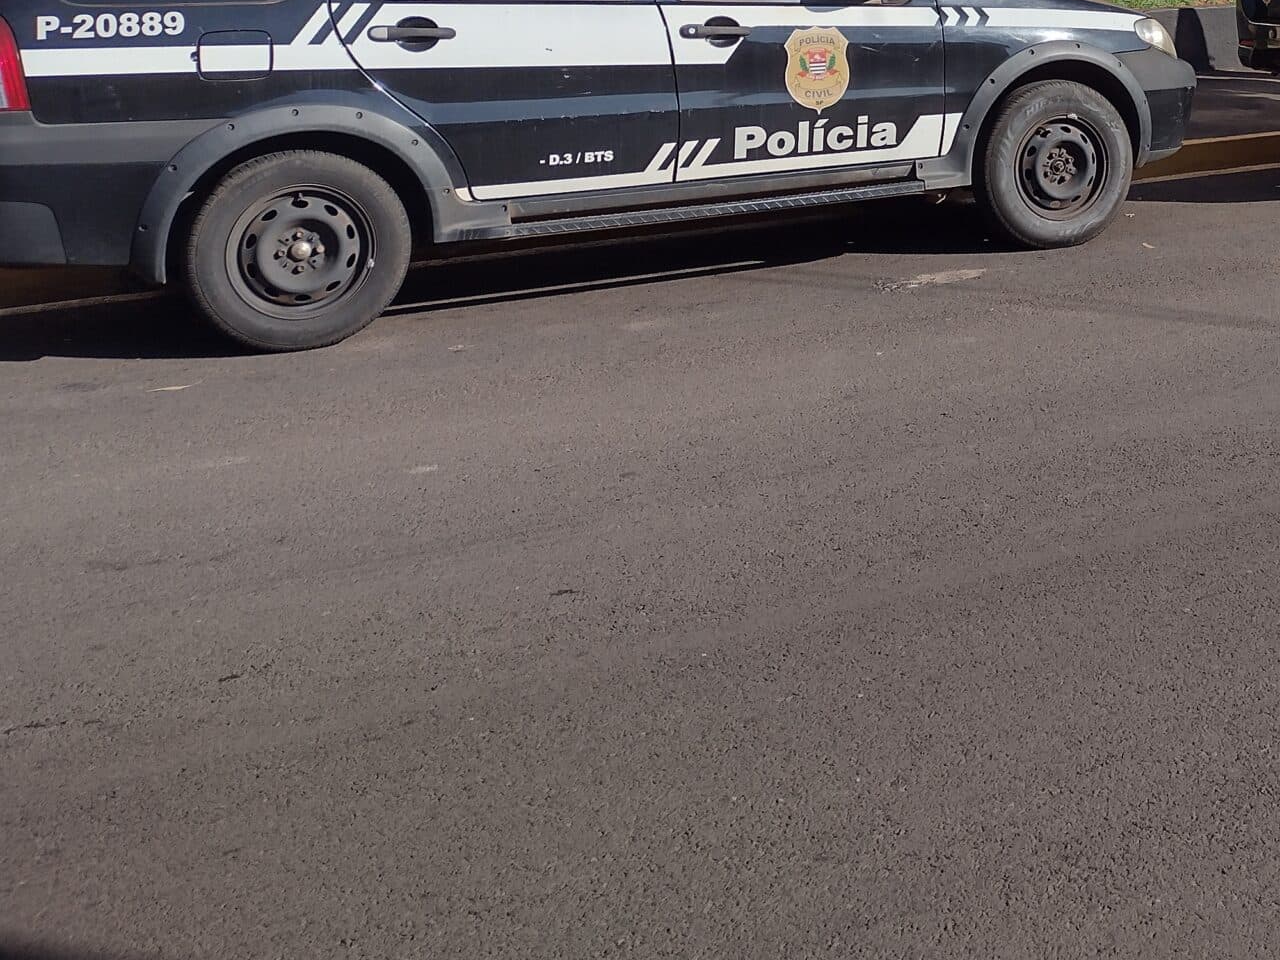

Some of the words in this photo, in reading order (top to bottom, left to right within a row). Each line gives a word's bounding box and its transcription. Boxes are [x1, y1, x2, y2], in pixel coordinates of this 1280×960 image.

[36, 11, 185, 40] P-20889
[804, 89, 833, 98] CIVIL
[734, 115, 897, 160] Polícia
[549, 152, 573, 166] D.3
[584, 150, 614, 163] BTS
